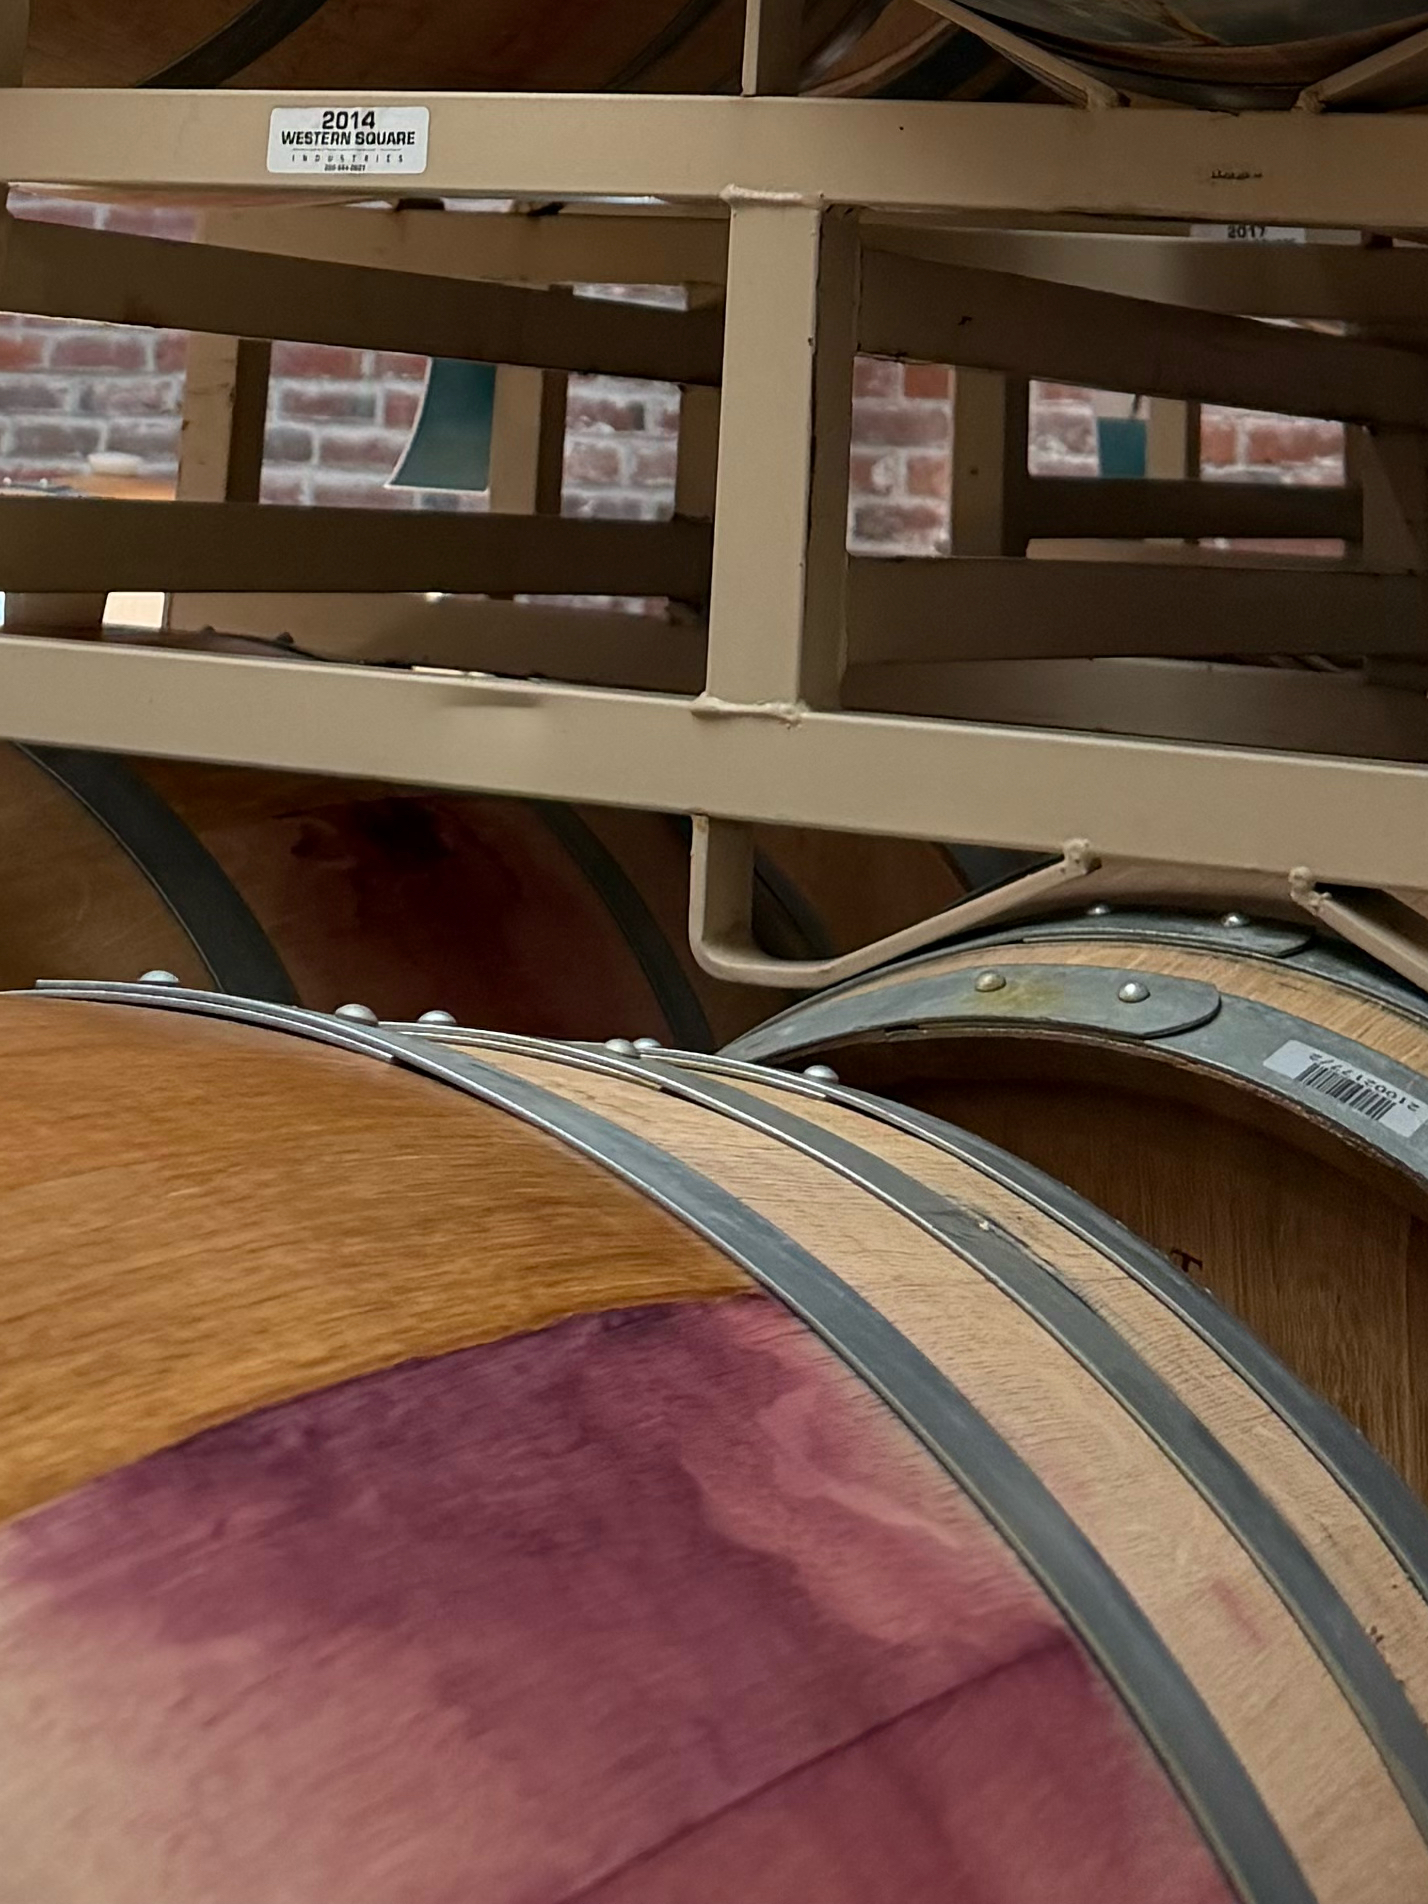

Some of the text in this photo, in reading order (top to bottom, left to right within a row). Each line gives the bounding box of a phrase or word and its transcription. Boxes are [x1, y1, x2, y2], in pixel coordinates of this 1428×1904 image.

[321, 110, 376, 130] 2014
[281, 130, 416, 146] WESTERN SQUARE
[291, 154, 404, 164] INDUSTRIES
[1227, 224, 1267, 239] 2017
